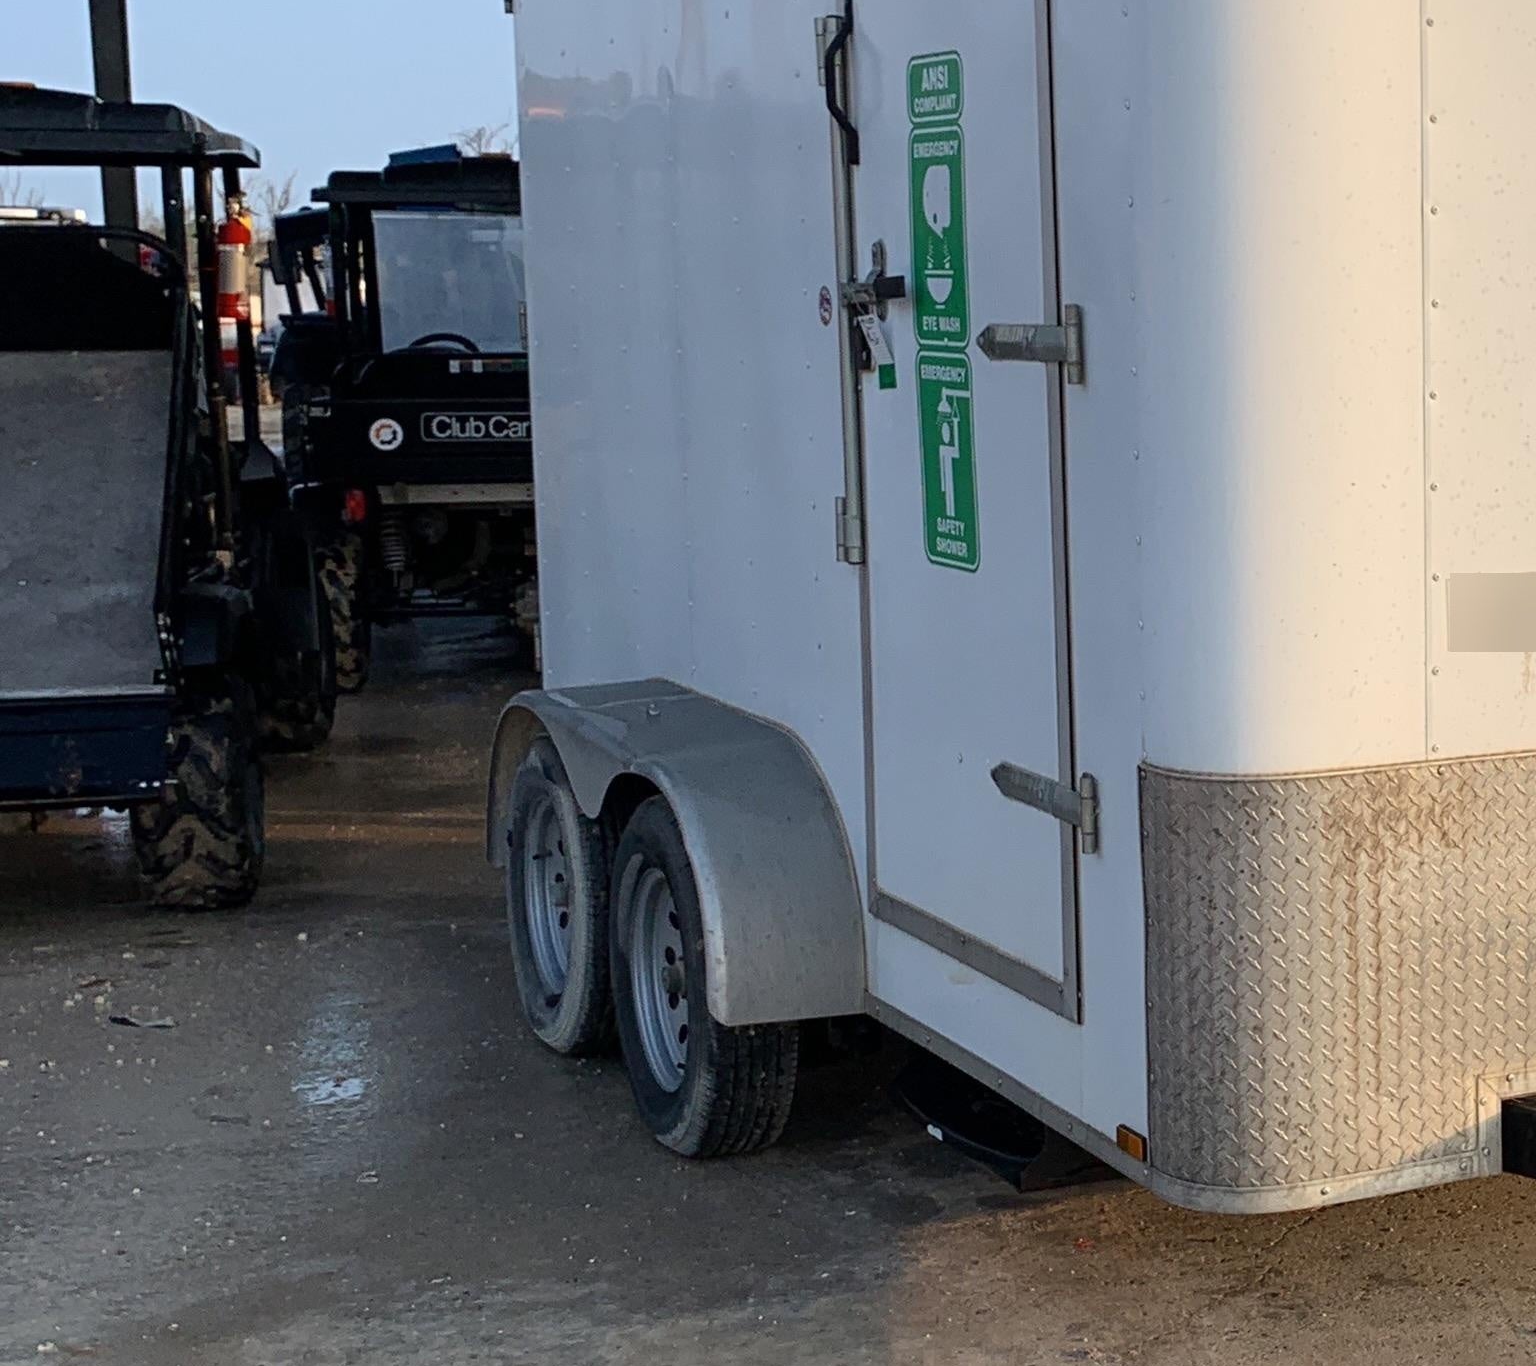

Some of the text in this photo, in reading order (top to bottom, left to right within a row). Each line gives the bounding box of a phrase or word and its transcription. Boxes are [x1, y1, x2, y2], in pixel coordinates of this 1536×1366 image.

[921, 64, 949, 92] ANSI
[913, 93, 957, 115] COMPLIANT
[913, 140, 959, 158] EMERGENCY
[922, 315, 938, 331] EYE
[431, 415, 531, 438] Club Car
[936, 516, 965, 537] SAFETY
[936, 536, 968, 558] SHOWER
